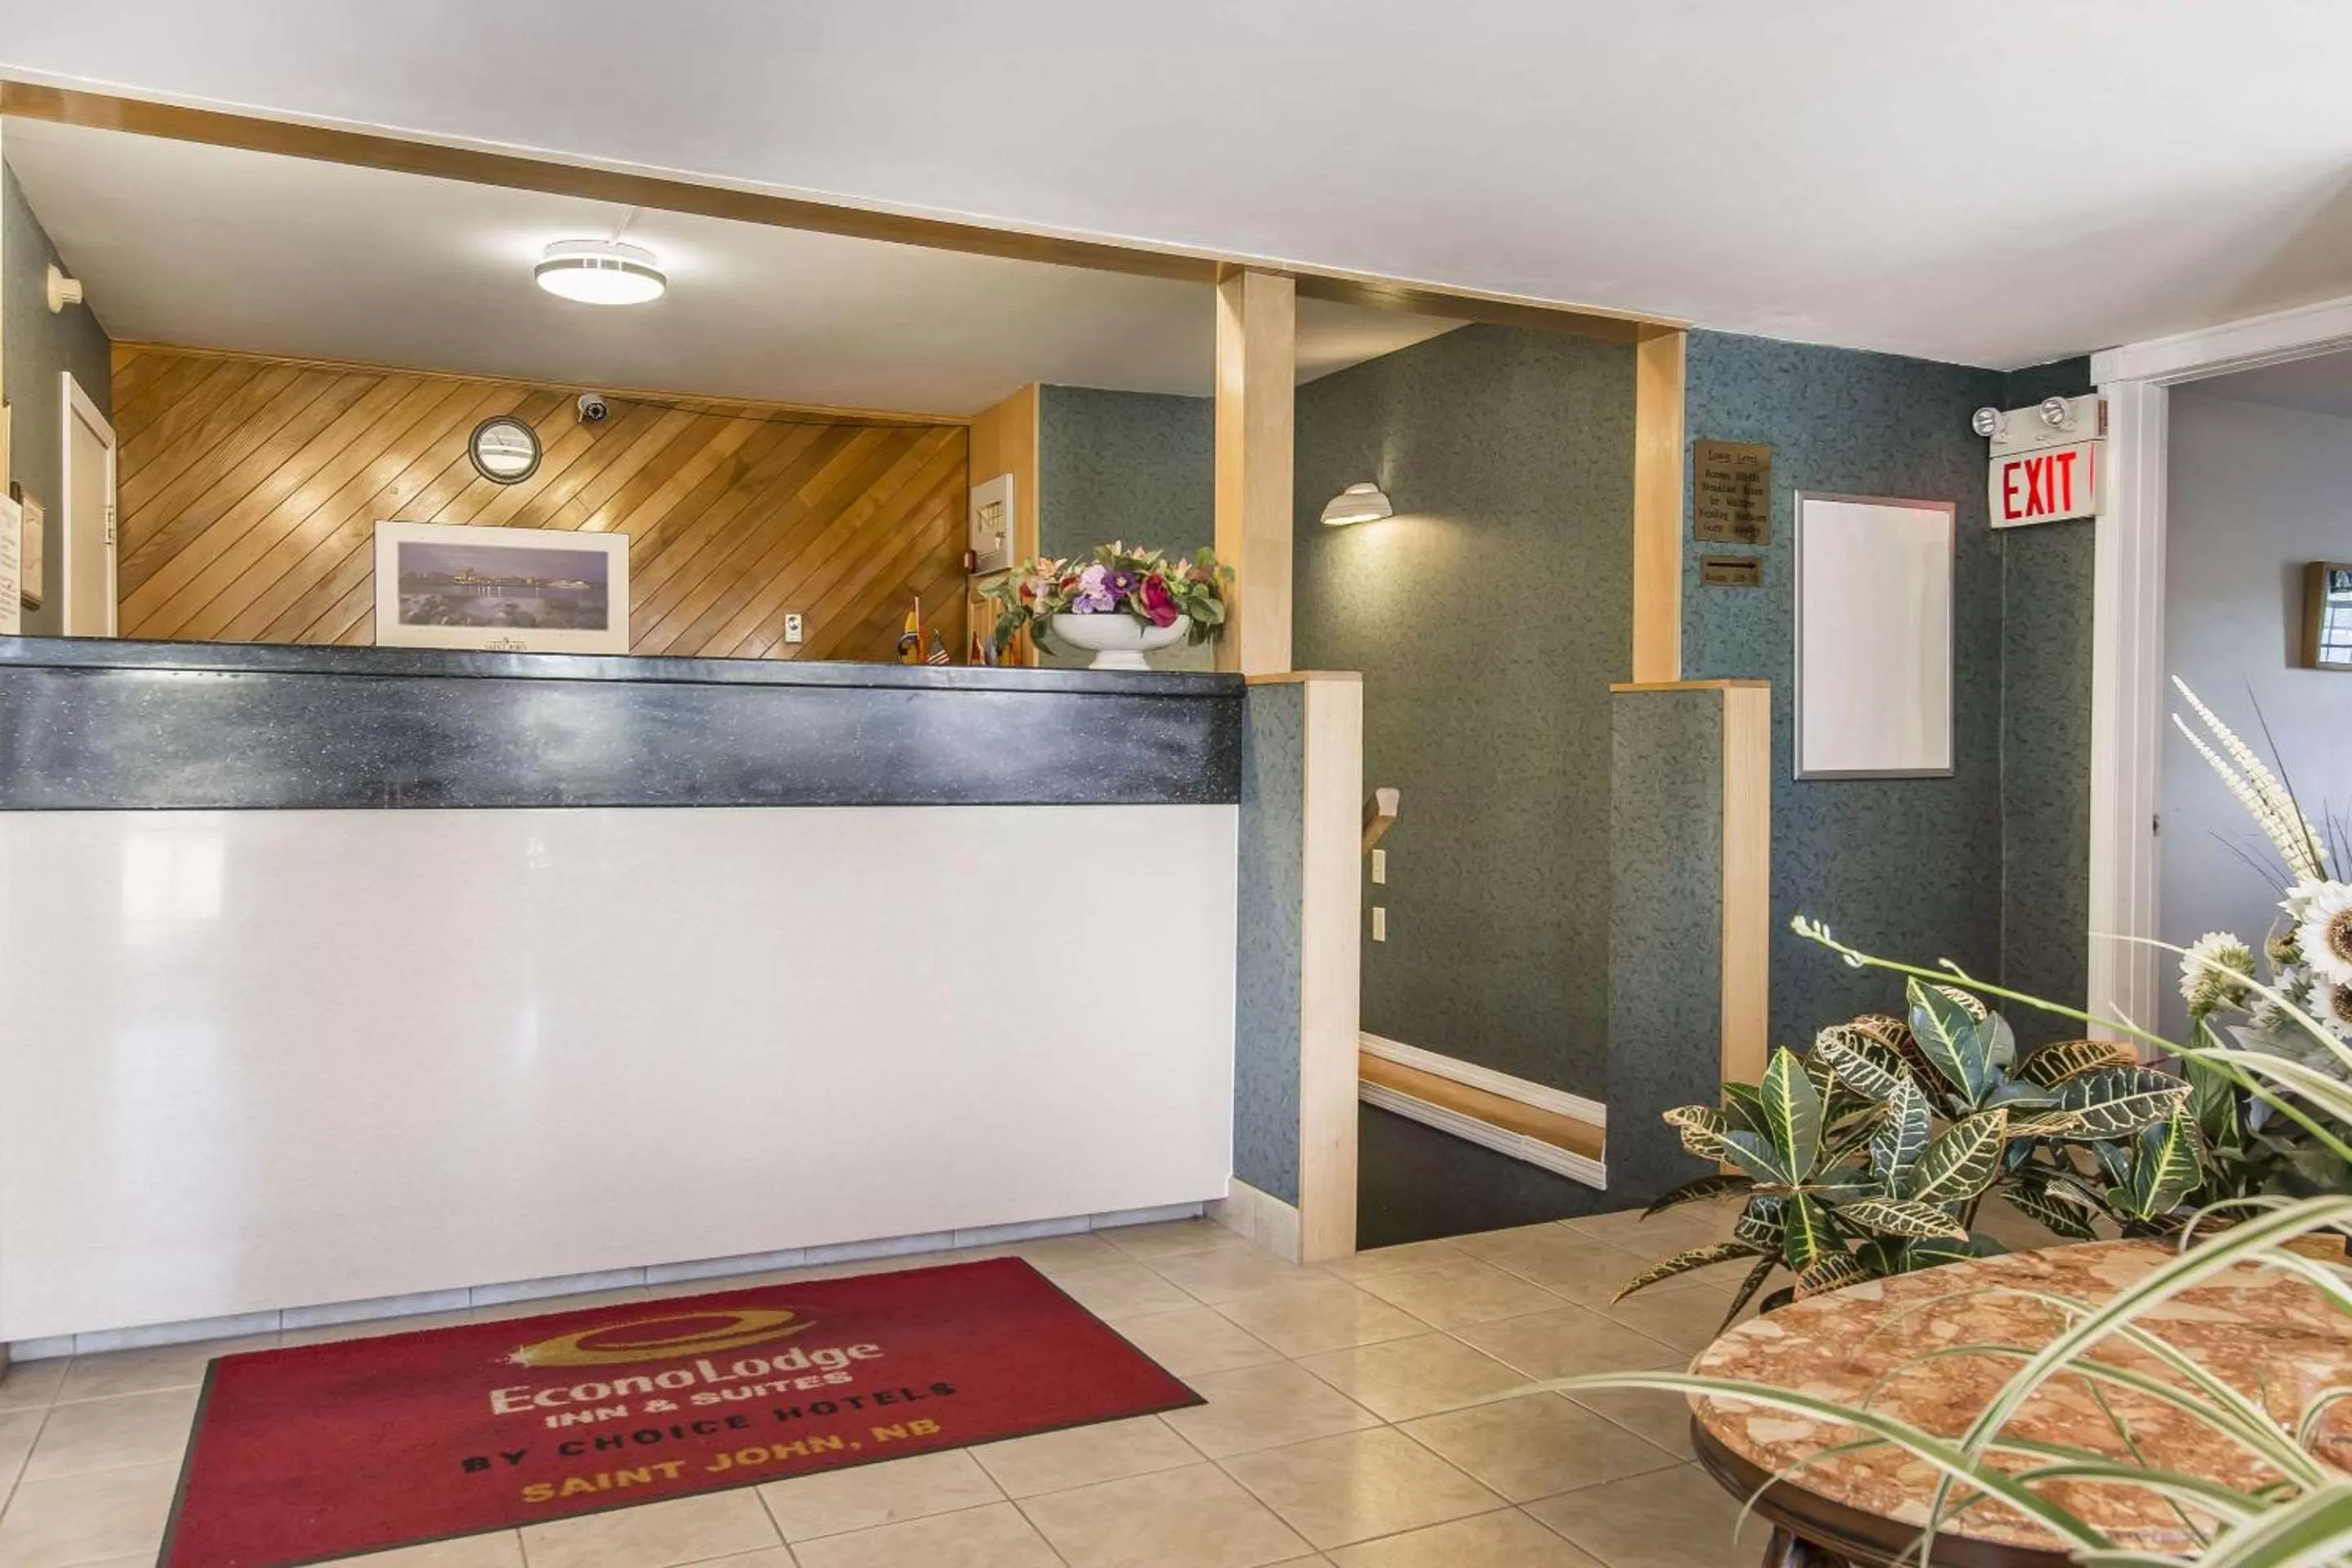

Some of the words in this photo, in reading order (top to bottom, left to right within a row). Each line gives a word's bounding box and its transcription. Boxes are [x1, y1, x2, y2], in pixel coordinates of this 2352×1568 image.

[2003, 452, 2077, 519] EXIT
[461, 1448, 528, 1473] BY
[559, 1414, 750, 1457] CHOICE
[773, 1382, 956, 1422] HOTELS
[545, 1405, 628, 1428] INN
[644, 1400, 679, 1414] &
[690, 1370, 853, 1405] SUITES
[521, 1460, 686, 1503] SAINT
[704, 1435, 862, 1472] JOHN,
[871, 1419, 941, 1443] NB
